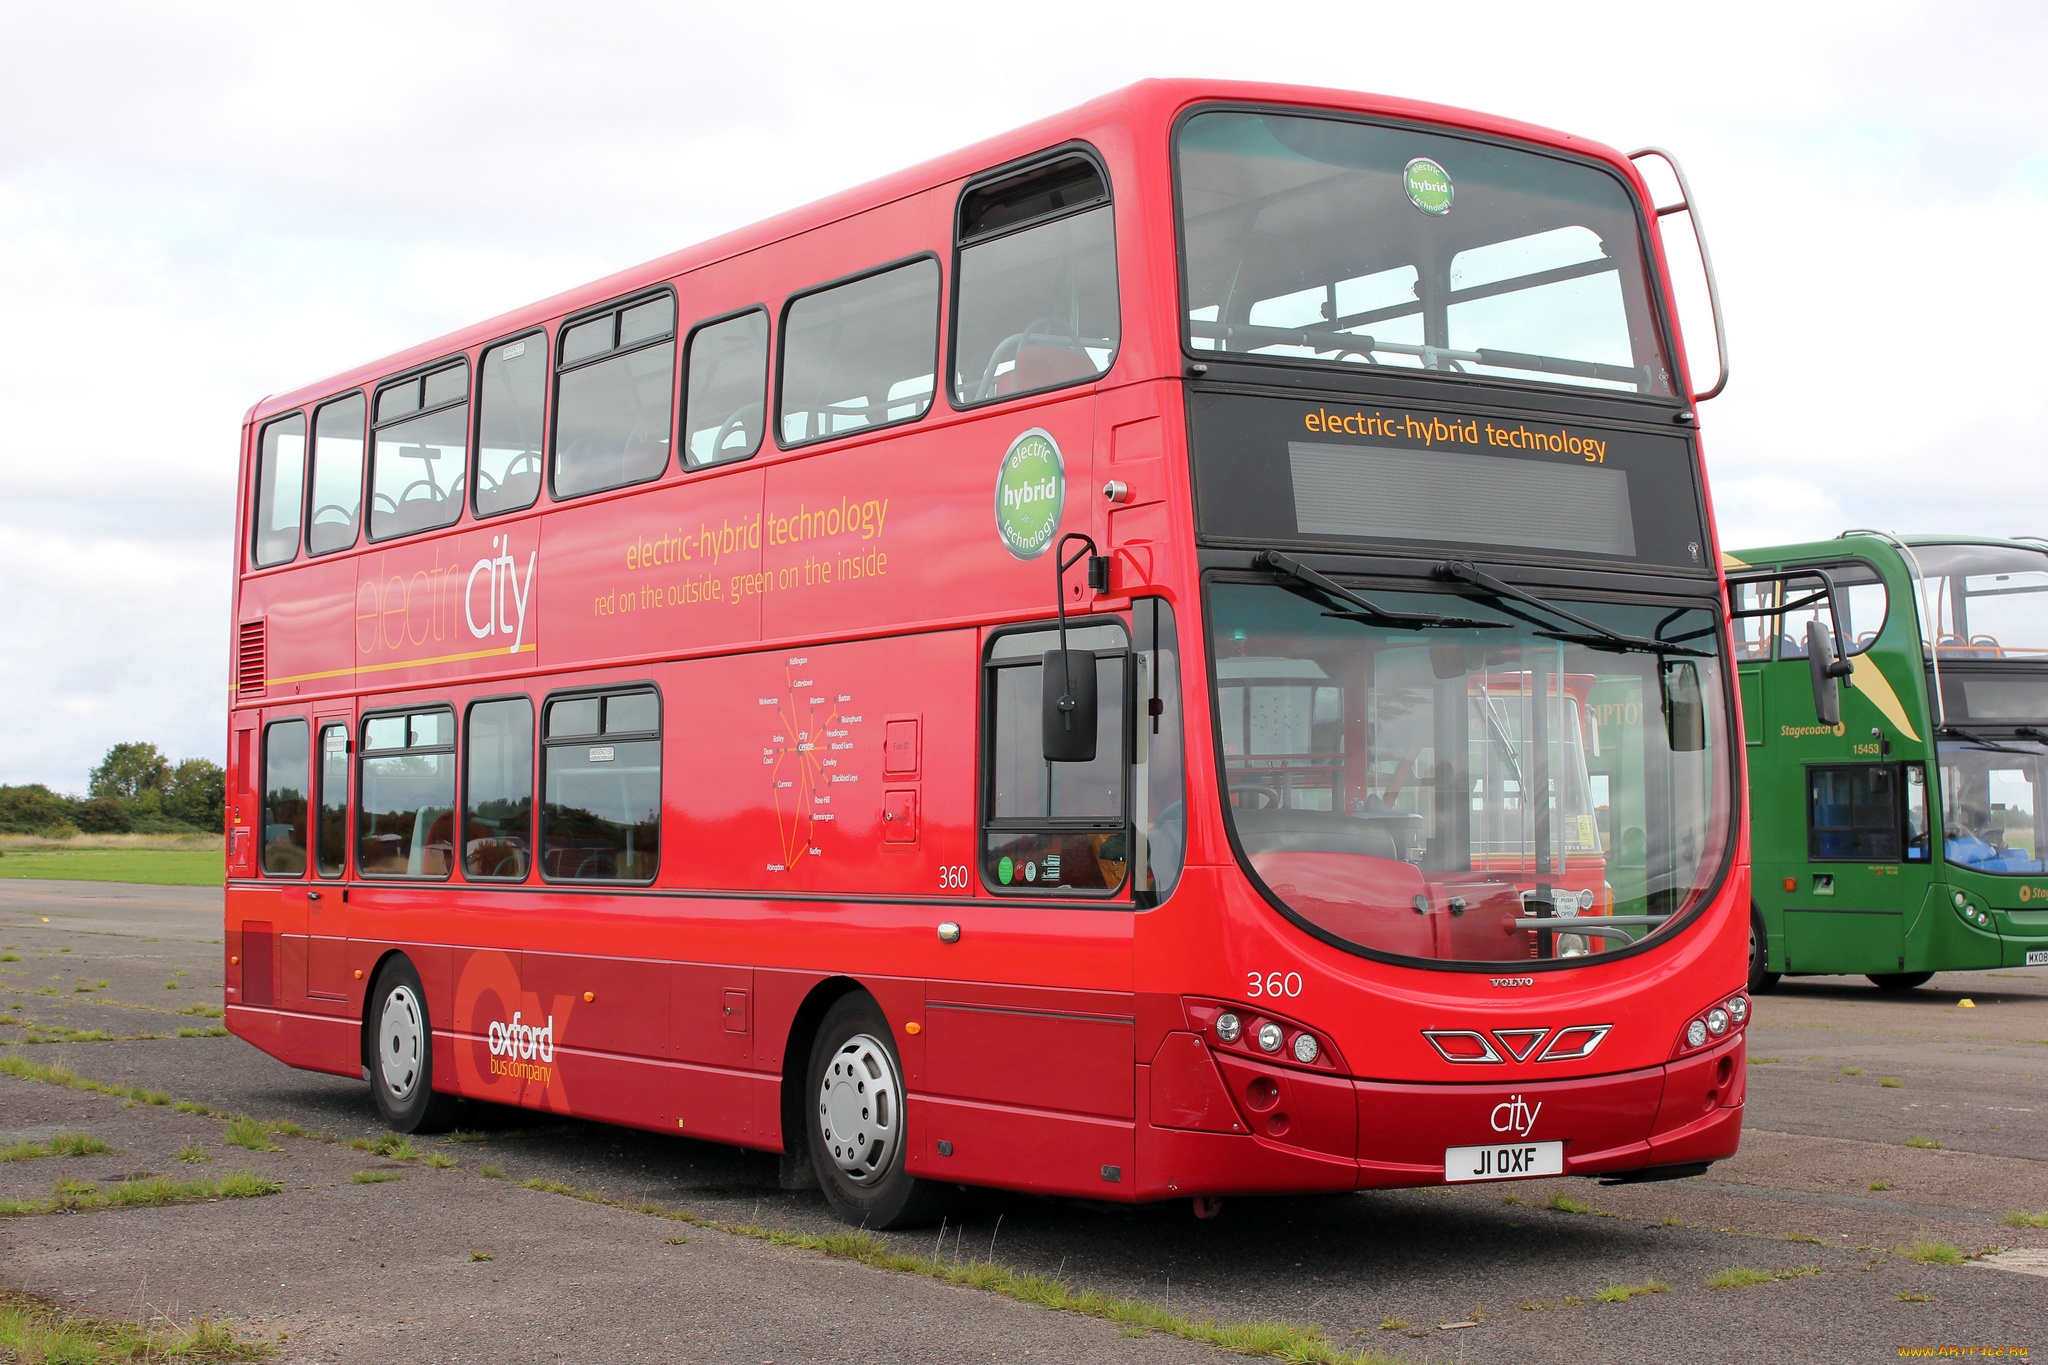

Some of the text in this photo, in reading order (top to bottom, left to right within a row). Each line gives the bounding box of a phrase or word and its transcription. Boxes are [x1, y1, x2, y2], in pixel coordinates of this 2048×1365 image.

[1412, 163, 1441, 177] electric
[1410, 178, 1448, 193] hybrid
[1413, 194, 1451, 212] technology
[1304, 408, 1607, 463] electric-hybrid technology
[1011, 441, 1051, 469] electric
[1004, 476, 1056, 510] hybrid
[626, 496, 889, 570] electric-hybrid technology
[1003, 512, 1055, 549] technology
[594, 546, 888, 616] red on the outside, green on the inside
[1780, 725, 1832, 739] Stagecoach
[1853, 743, 1880, 754] 15453
[938, 865, 968, 889] 360
[1246, 971, 1303, 998] 360
[1489, 977, 1534, 988] VOLVO
[488, 1011, 554, 1063] oxford
[490, 1054, 552, 1088] bus company
[1490, 1094, 1542, 1137] city
[1497, 1147, 1537, 1173] OXF
